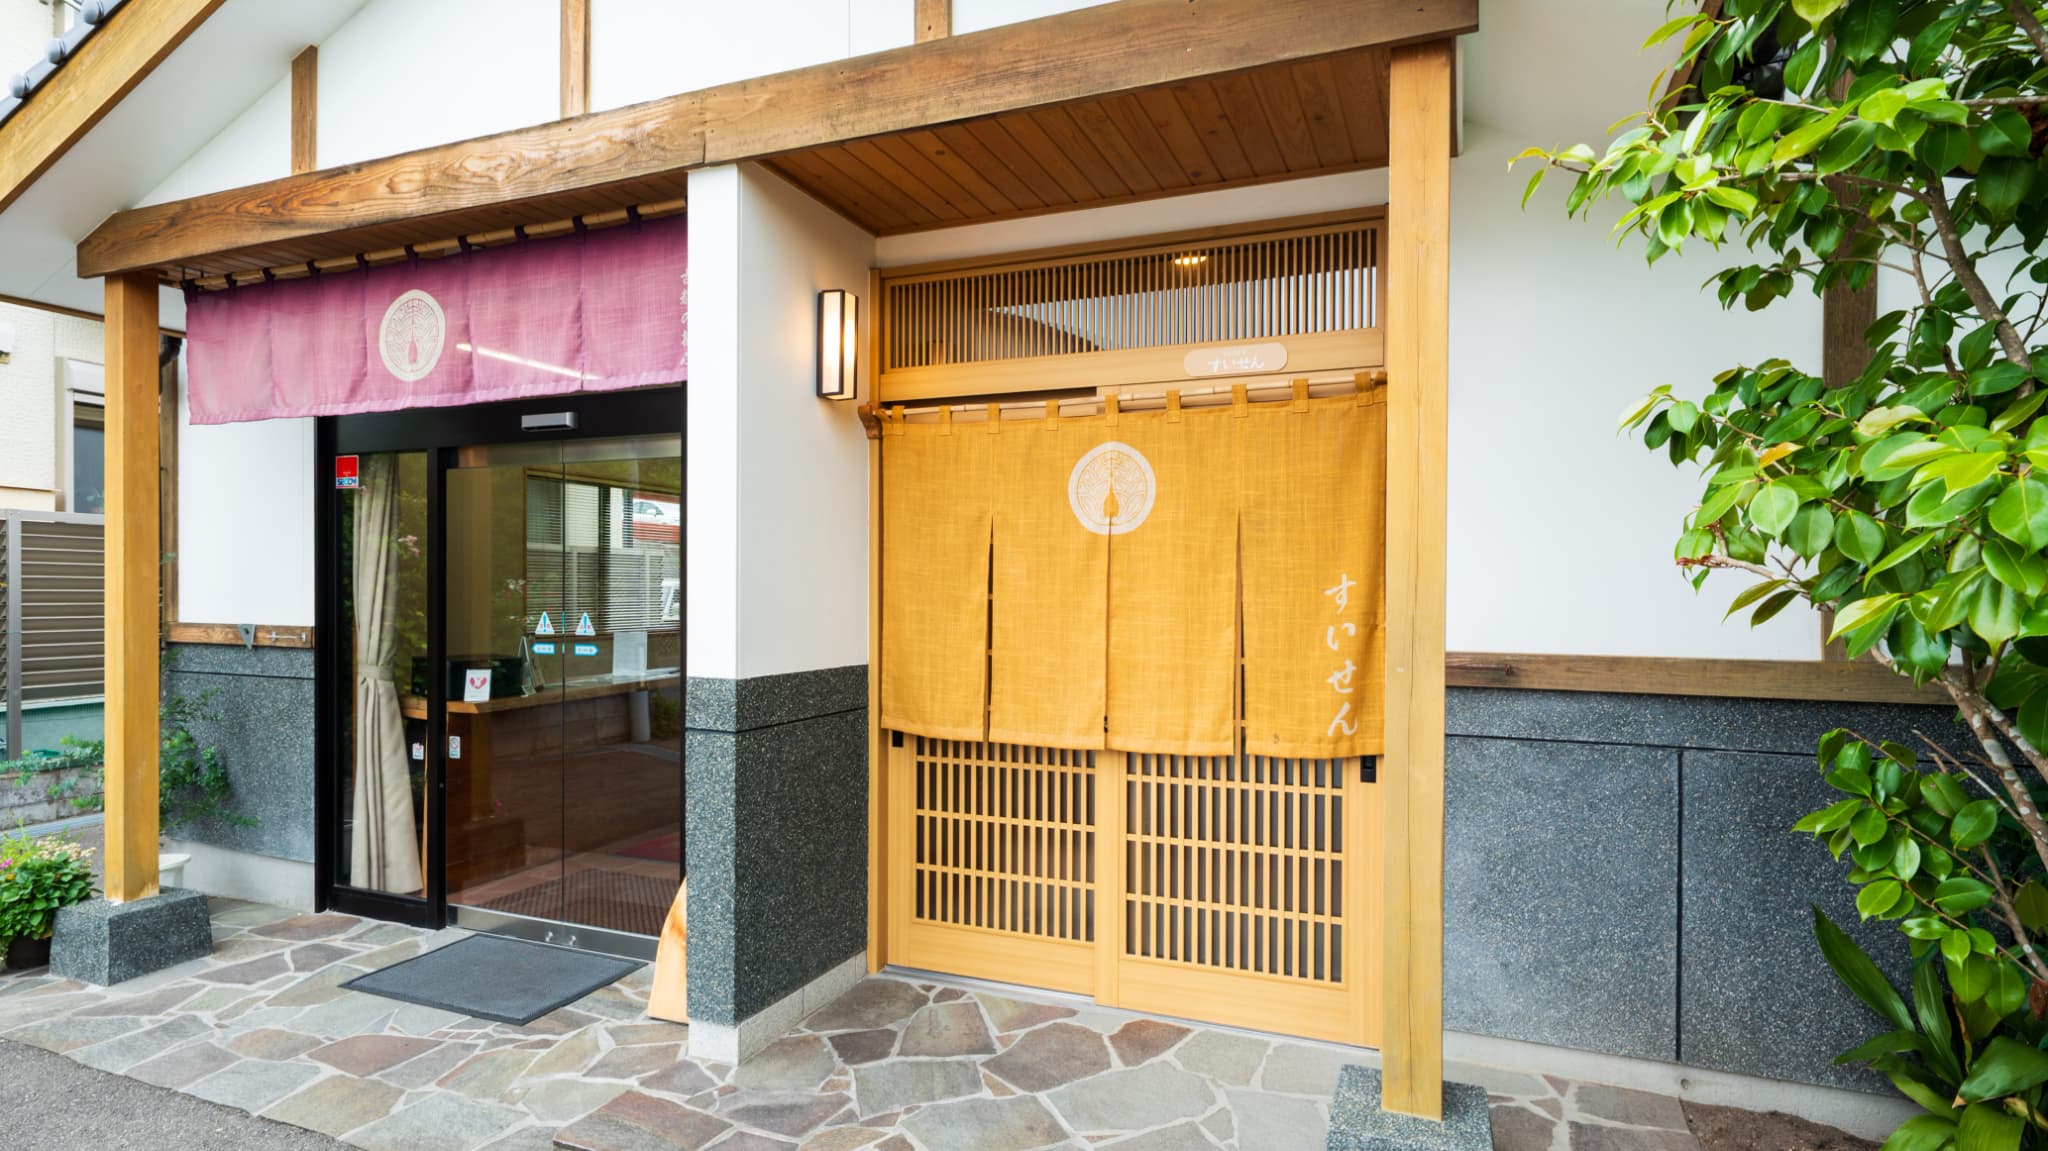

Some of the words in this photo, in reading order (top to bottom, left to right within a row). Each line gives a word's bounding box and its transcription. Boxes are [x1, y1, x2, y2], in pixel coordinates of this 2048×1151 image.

[1207, 354, 1265, 373] すいせん
[1323, 573, 1358, 738] すいせん
